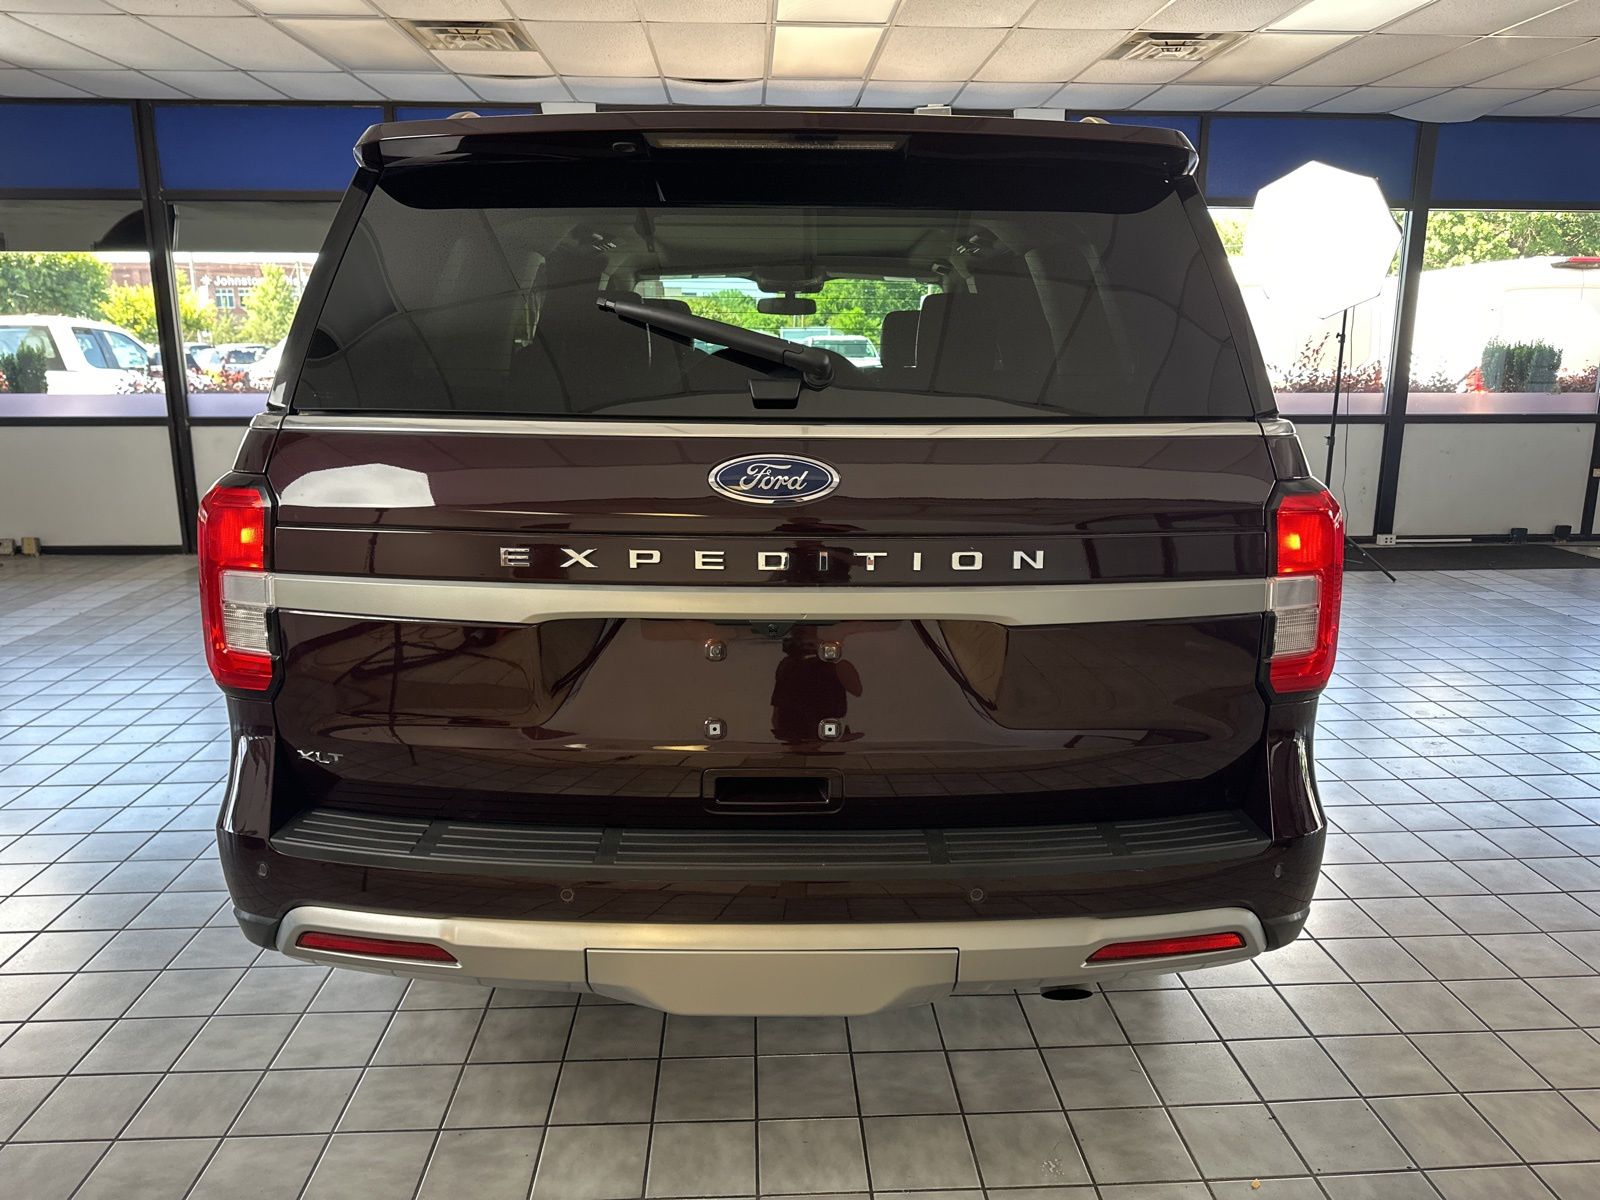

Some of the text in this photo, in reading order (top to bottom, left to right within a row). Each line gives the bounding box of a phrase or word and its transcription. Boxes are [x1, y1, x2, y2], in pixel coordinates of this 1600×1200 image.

[213, 275, 263, 287] Johnsto
[739, 463, 809, 490] Ford
[500, 547, 1045, 571] EXPEDITION
[297, 749, 344, 764] XLT
